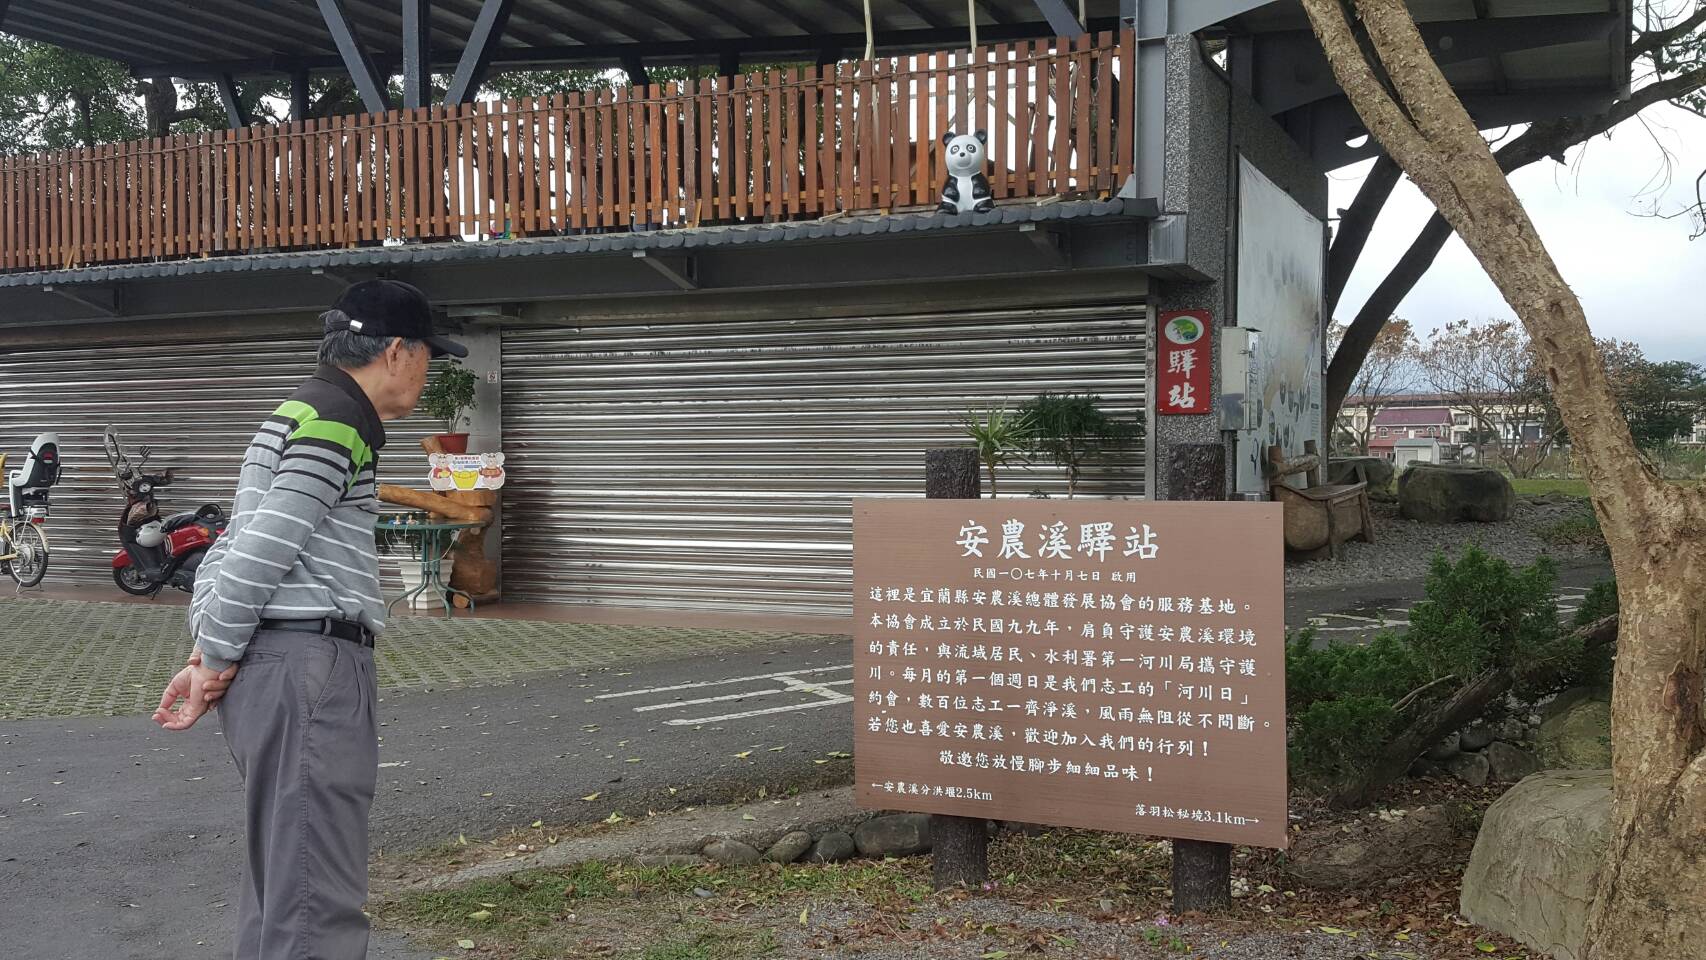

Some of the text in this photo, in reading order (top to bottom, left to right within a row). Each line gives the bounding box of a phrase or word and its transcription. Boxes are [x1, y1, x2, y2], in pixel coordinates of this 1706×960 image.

[1168, 348, 1198, 408] 驛站
[955, 518, 1160, 562] 安農溪驛站
[869, 586, 1251, 615] 這裡是宜蘭縣安農溪總體發展協會的服務基地。
[869, 612, 1257, 646] 本協會成立於民國九九年，肩負守護安農溪環境
[939, 750, 1154, 782] 敬邀您放慢腳步細細品味！
